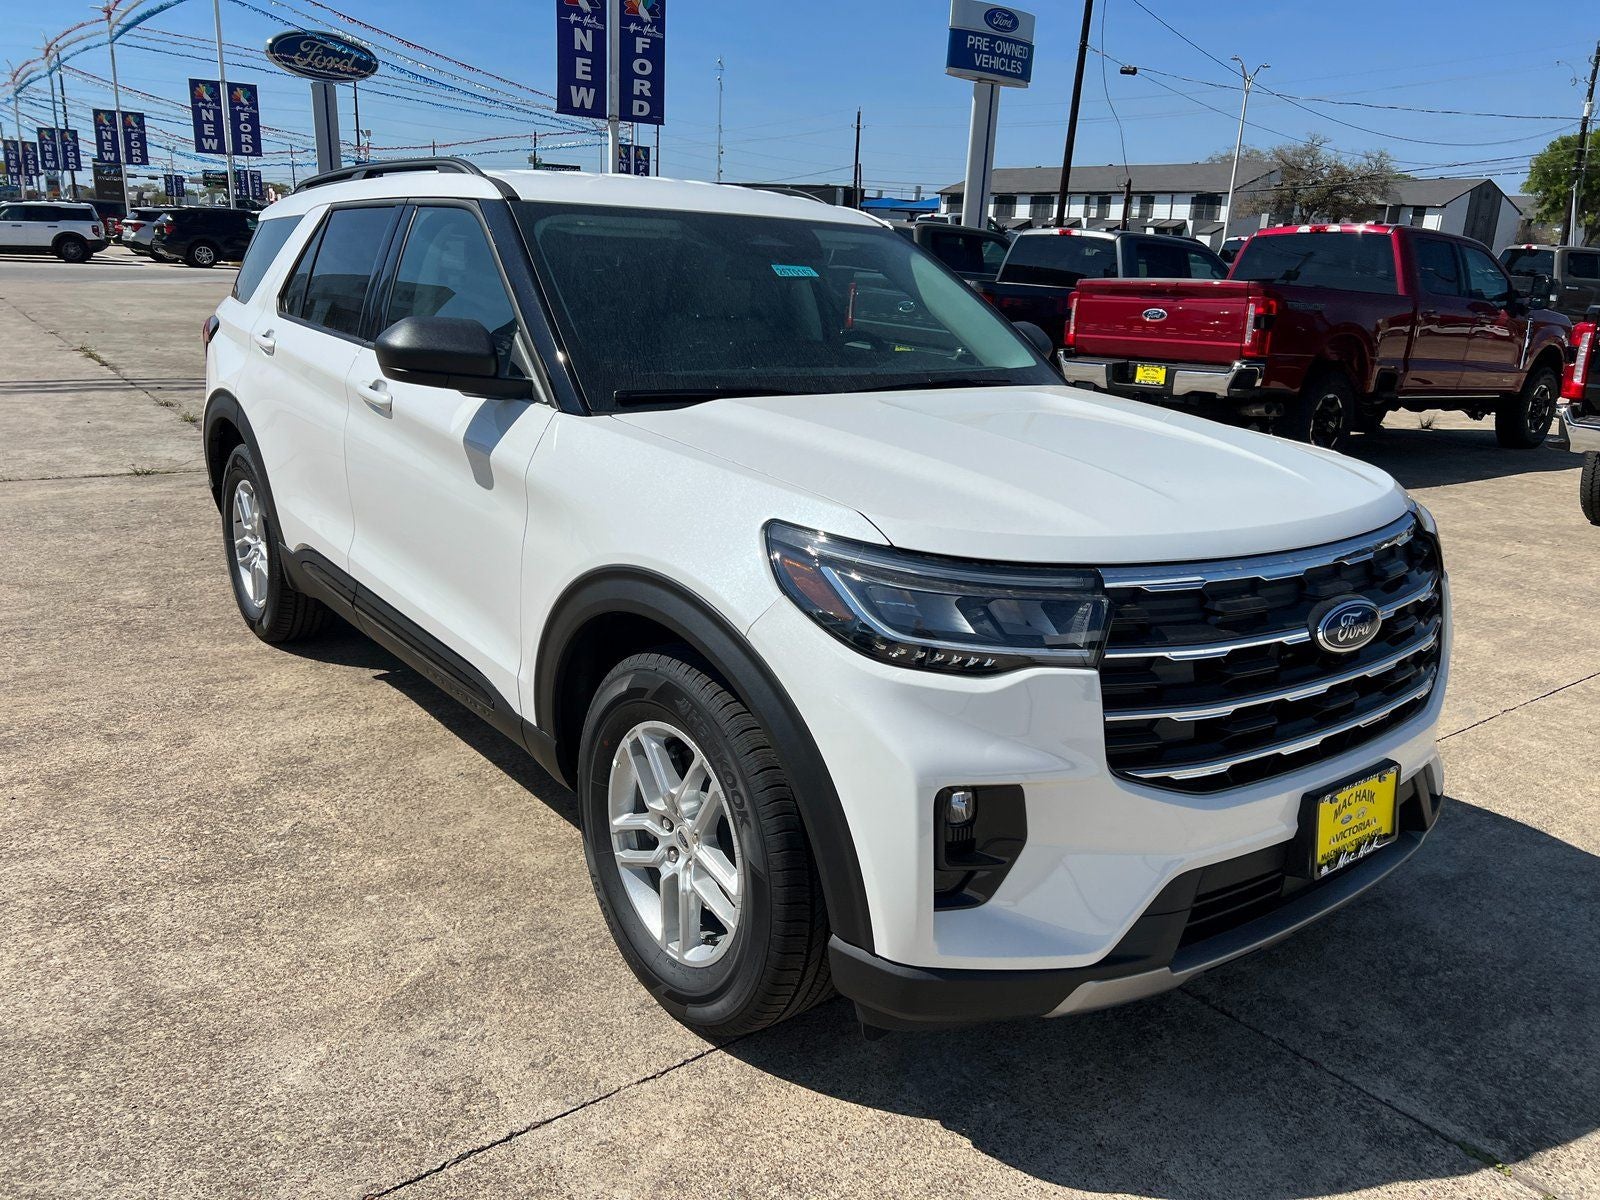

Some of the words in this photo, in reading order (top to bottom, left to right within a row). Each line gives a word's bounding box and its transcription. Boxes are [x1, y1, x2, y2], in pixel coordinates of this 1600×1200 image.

[992, 11, 1013, 28] Ford
[294, 39, 357, 71] Ford
[967, 35, 1029, 59] PRE-OWNED
[570, 28, 595, 109] NEW
[632, 37, 653, 116] FORD
[974, 53, 1022, 74] VEHICLES
[201, 108, 218, 150] NEW
[239, 112, 253, 153] FORD
[44, 144, 55, 168] NEW
[66, 145, 77, 169] FORD
[102, 131, 115, 161] NEW
[130, 133, 142, 163] FORD
[1337, 610, 1371, 642] Ford
[1333, 793, 1354, 823] MAC
[1354, 789, 1376, 804] HAIK
